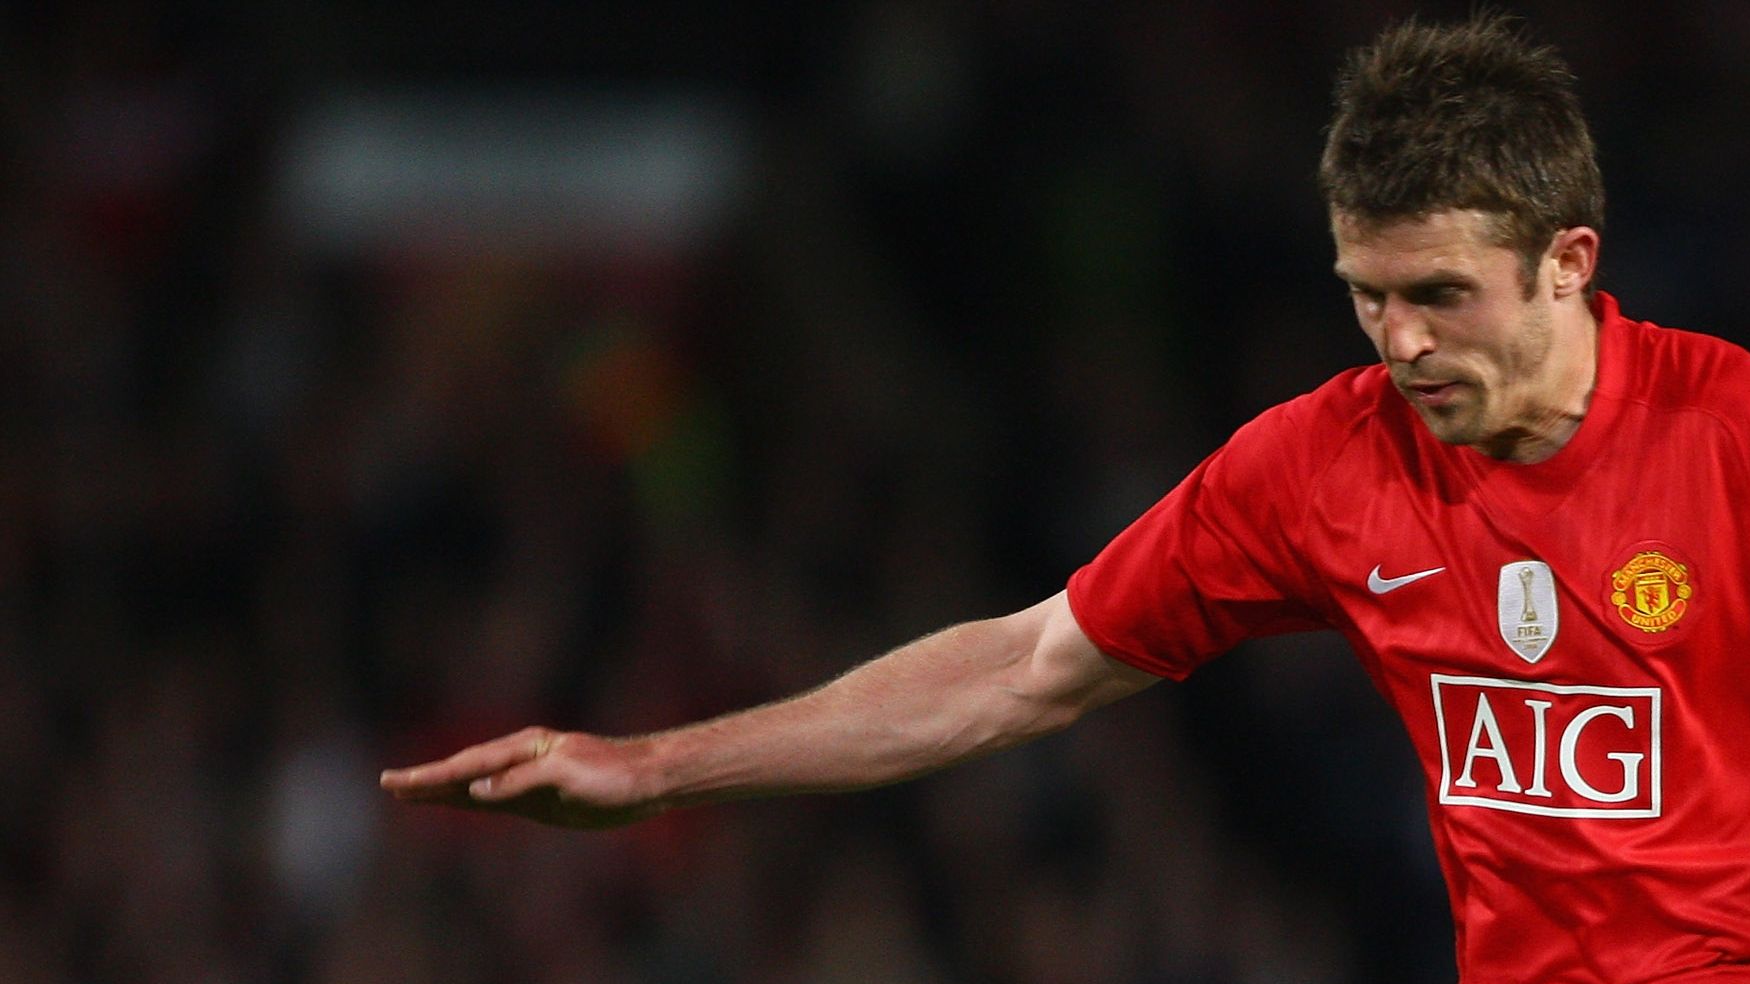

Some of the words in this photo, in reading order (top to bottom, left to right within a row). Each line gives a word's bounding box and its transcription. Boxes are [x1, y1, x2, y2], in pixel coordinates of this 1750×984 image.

[1631, 611, 1677, 627] UNITED
[1517, 626, 1541, 637] FIFA
[1455, 692, 1644, 802] AIG
